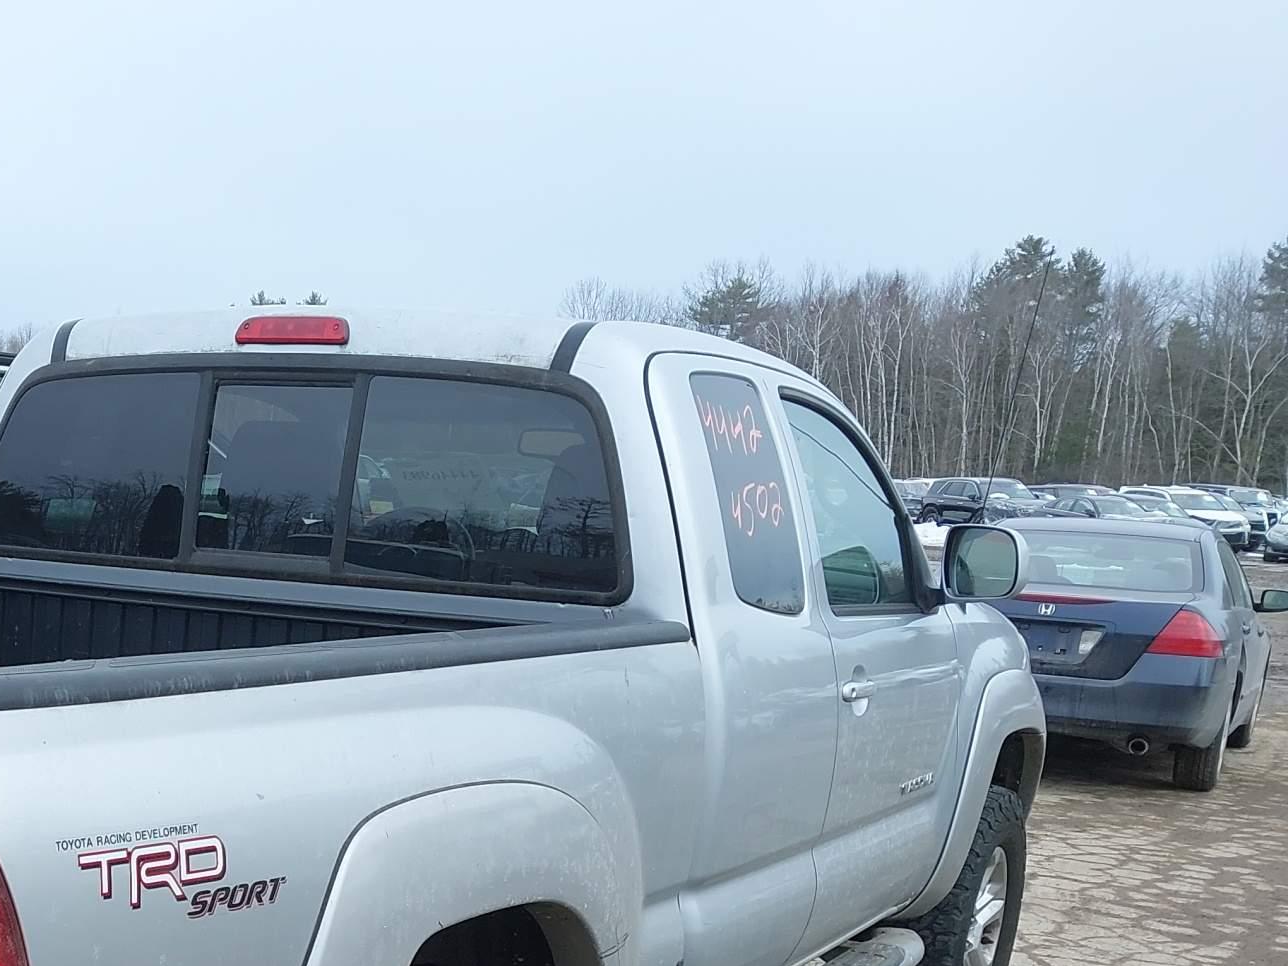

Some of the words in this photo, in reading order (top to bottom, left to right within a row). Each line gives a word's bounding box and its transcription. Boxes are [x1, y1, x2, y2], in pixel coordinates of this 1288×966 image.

[731, 482, 784, 536] 4502
[56, 838, 93, 851] TOYOTA
[96, 831, 133, 847] RACING
[135, 823, 199, 842] DEVELOPMENT
[78, 835, 227, 909] TRD
[187, 877, 286, 919] SPORT
